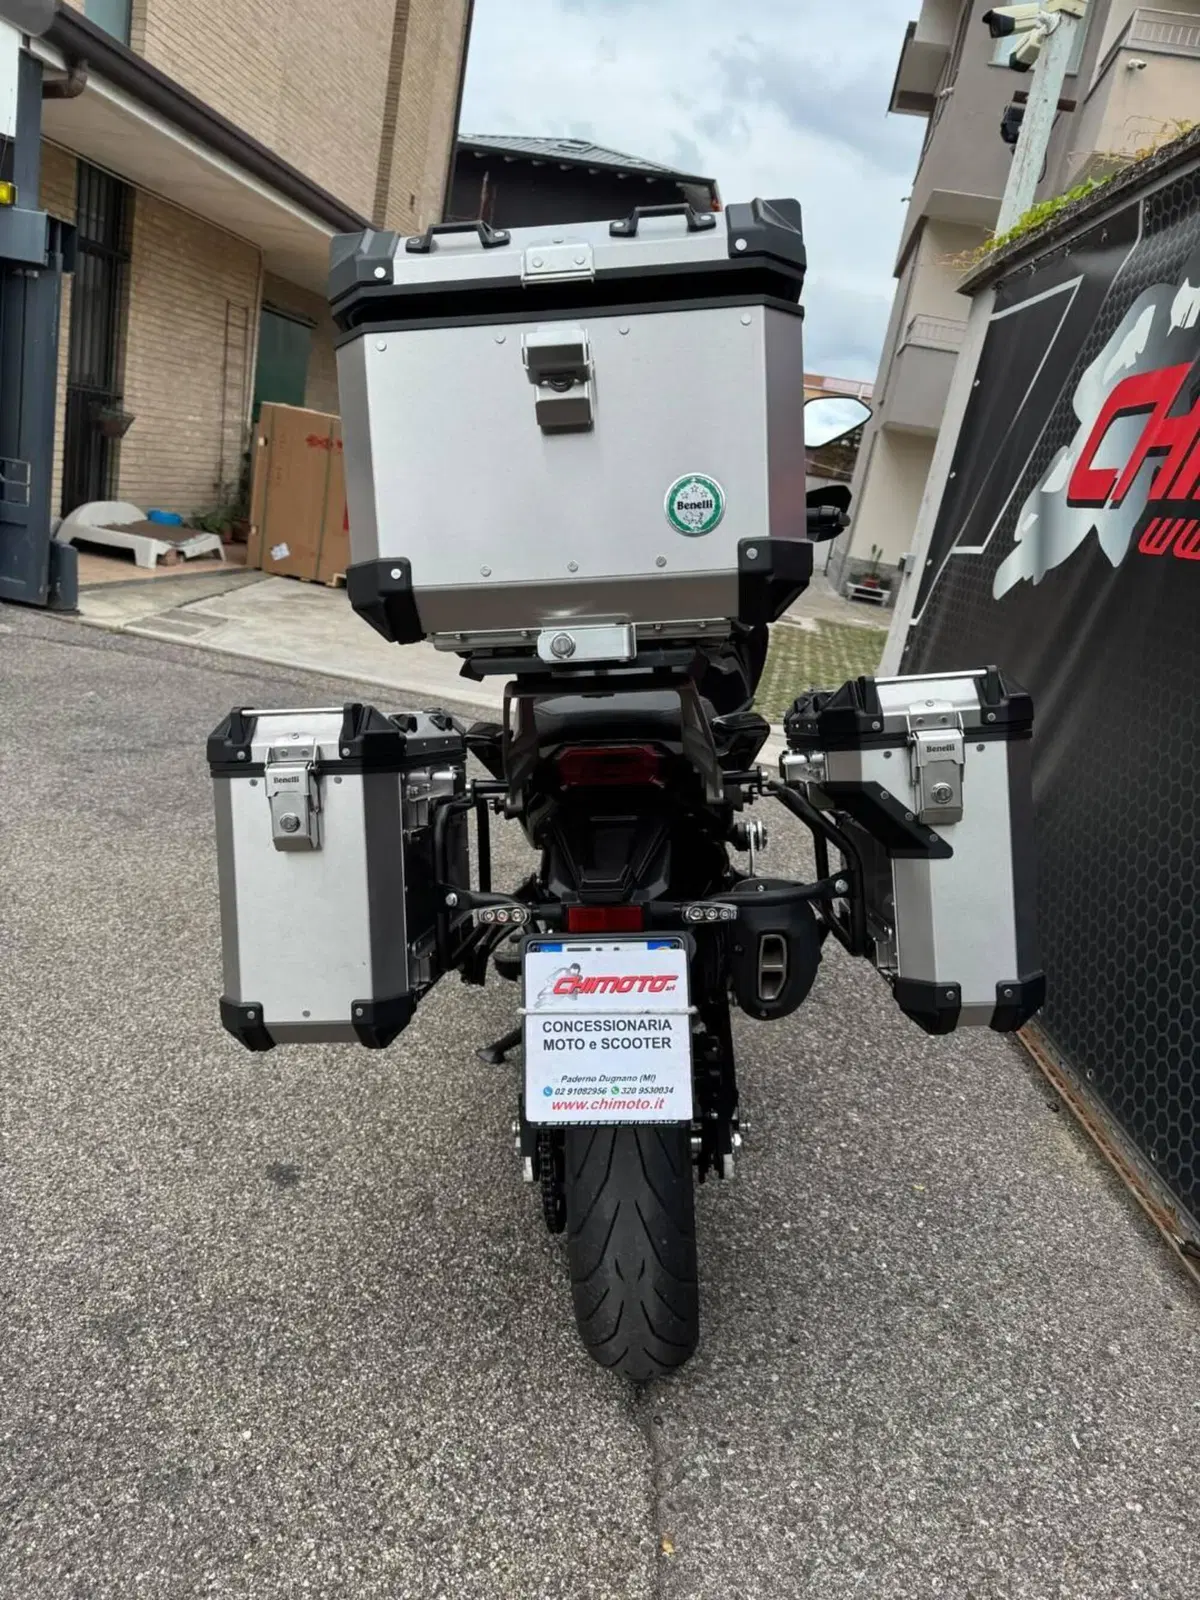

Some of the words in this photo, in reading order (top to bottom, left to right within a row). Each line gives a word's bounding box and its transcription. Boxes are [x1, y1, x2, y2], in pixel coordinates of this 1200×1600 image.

[677, 499, 713, 510] Benelli
[926, 743, 955, 752] Benelli
[273, 776, 300, 784] Benelli
[553, 975, 678, 994] CHIMOTO
[542, 1018, 672, 1033] CONCESSIONARIA
[543, 1038, 586, 1051] MOTO
[589, 1040, 597, 1050] e
[601, 1036, 672, 1050] SCOOTER
[560, 1074, 597, 1083] Paderno
[599, 1074, 638, 1084] Dugnano
[639, 1073, 657, 1083] (MI)
[554, 1087, 566, 1096] 02
[567, 1086, 608, 1096] 91082956
[620, 1086, 637, 1095] 320
[638, 1085, 675, 1095] 9530034
[551, 1097, 665, 1110] www.chimoto.it
